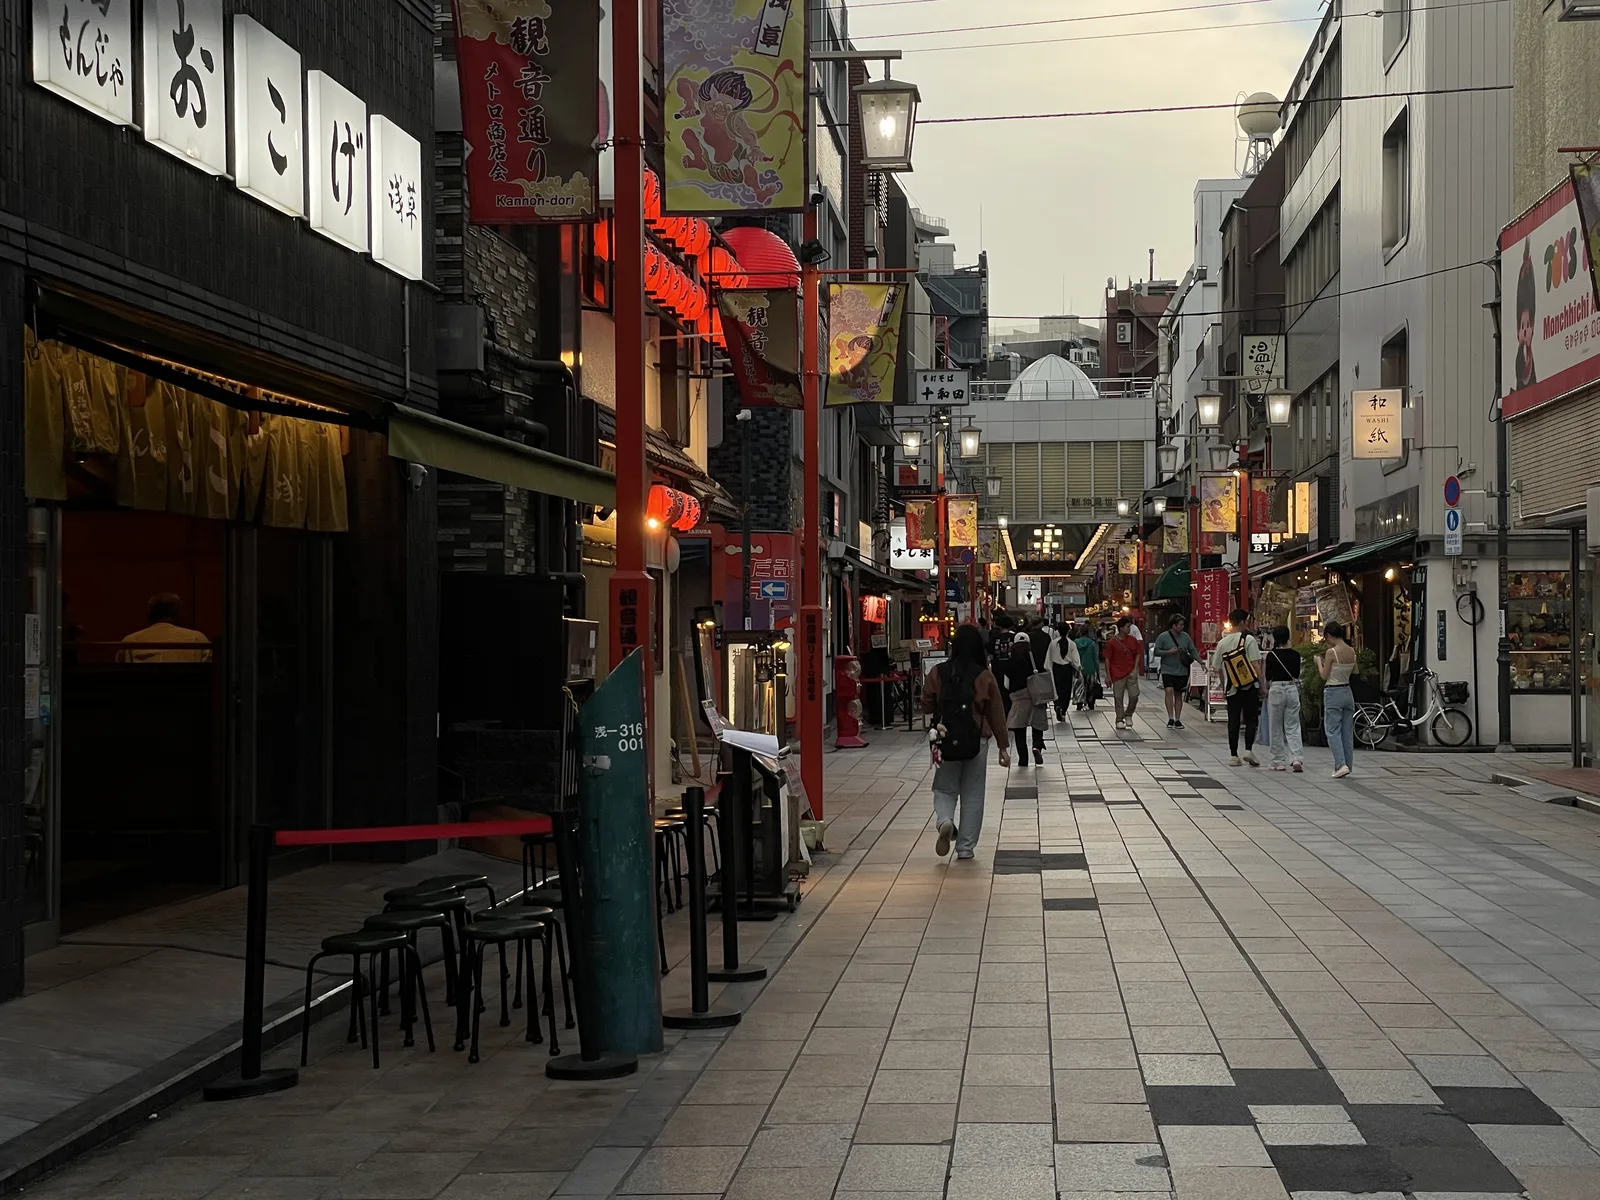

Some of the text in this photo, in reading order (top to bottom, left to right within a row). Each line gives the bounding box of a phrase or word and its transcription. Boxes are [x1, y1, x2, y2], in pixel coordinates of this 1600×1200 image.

[59, 4, 125, 97] もんじゃ
[484, 62, 509, 182] メトロ商店会
[514, 16, 551, 183] 観音通り
[388, 173, 418, 231] 浅草
[496, 194, 575, 207] Kannon-dori
[1544, 226, 1577, 293] TOYS
[1543, 292, 1589, 341] Monchhichi
[921, 386, 965, 401] 十和田
[1368, 394, 1387, 411] 和
[1368, 427, 1389, 443] 紙
[618, 737, 643, 752] 001
